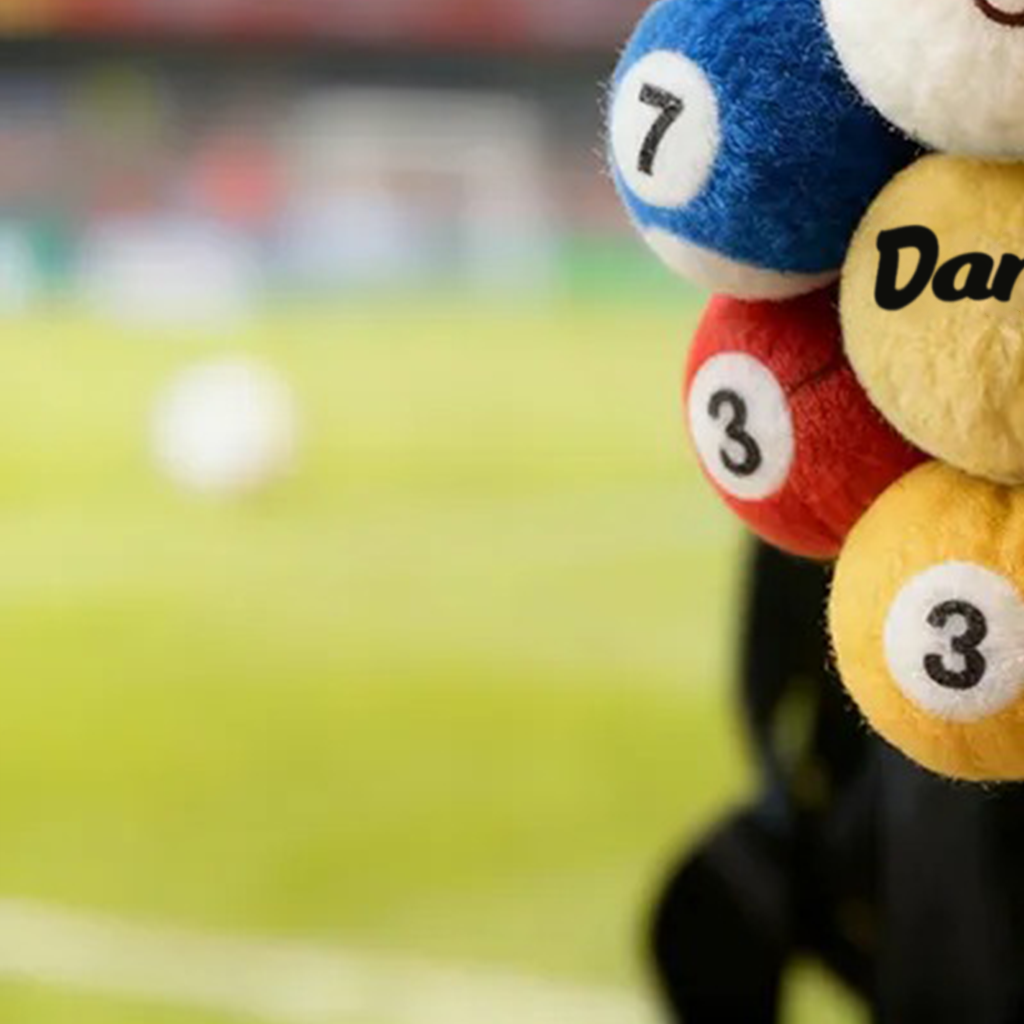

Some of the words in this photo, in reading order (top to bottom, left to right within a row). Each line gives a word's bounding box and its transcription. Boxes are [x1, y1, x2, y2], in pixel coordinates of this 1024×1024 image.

[638, 83, 684, 176] 7
[707, 388, 762, 475] 3
[924, 601, 987, 689] 3
